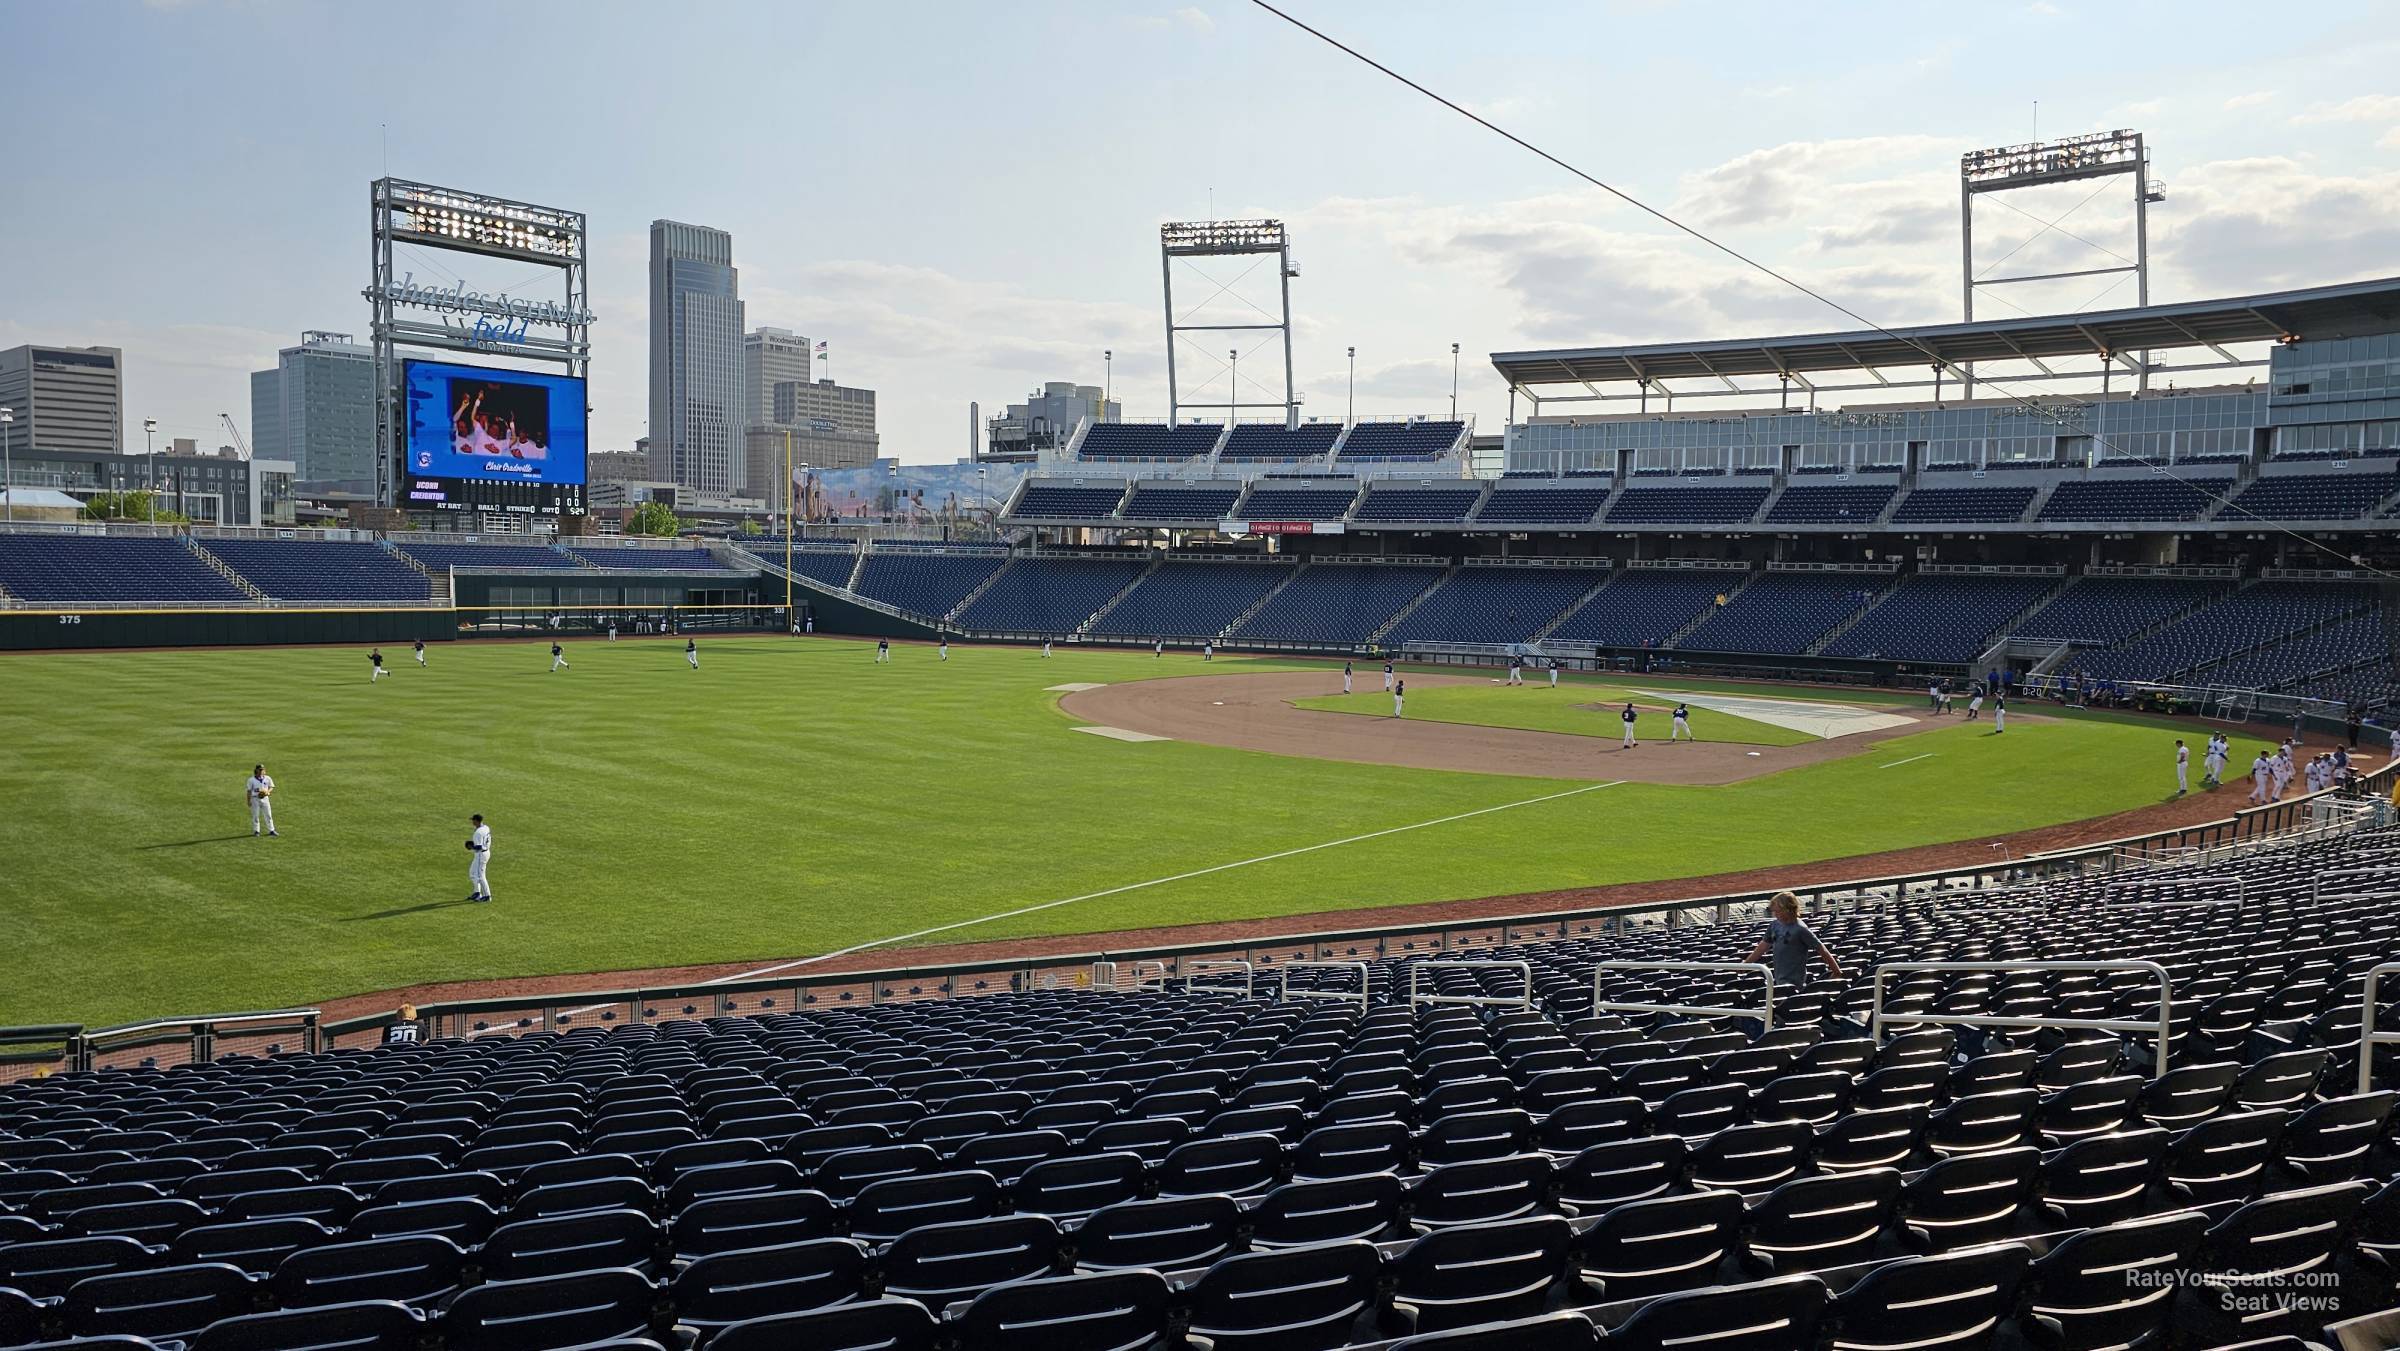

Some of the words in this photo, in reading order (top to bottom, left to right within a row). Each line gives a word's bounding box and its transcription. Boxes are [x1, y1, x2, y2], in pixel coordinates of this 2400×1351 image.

[499, 293, 594, 325] SCHWAB
[465, 312, 529, 347] field
[477, 340, 521, 354] OMAHA
[555, 498, 560, 506] 0
[567, 498, 571, 506] 0
[574, 498, 579, 506] 0
[60, 616, 80, 624] 375
[2022, 687, 2042, 696] 0:20
[390, 1030, 416, 1042] 20
